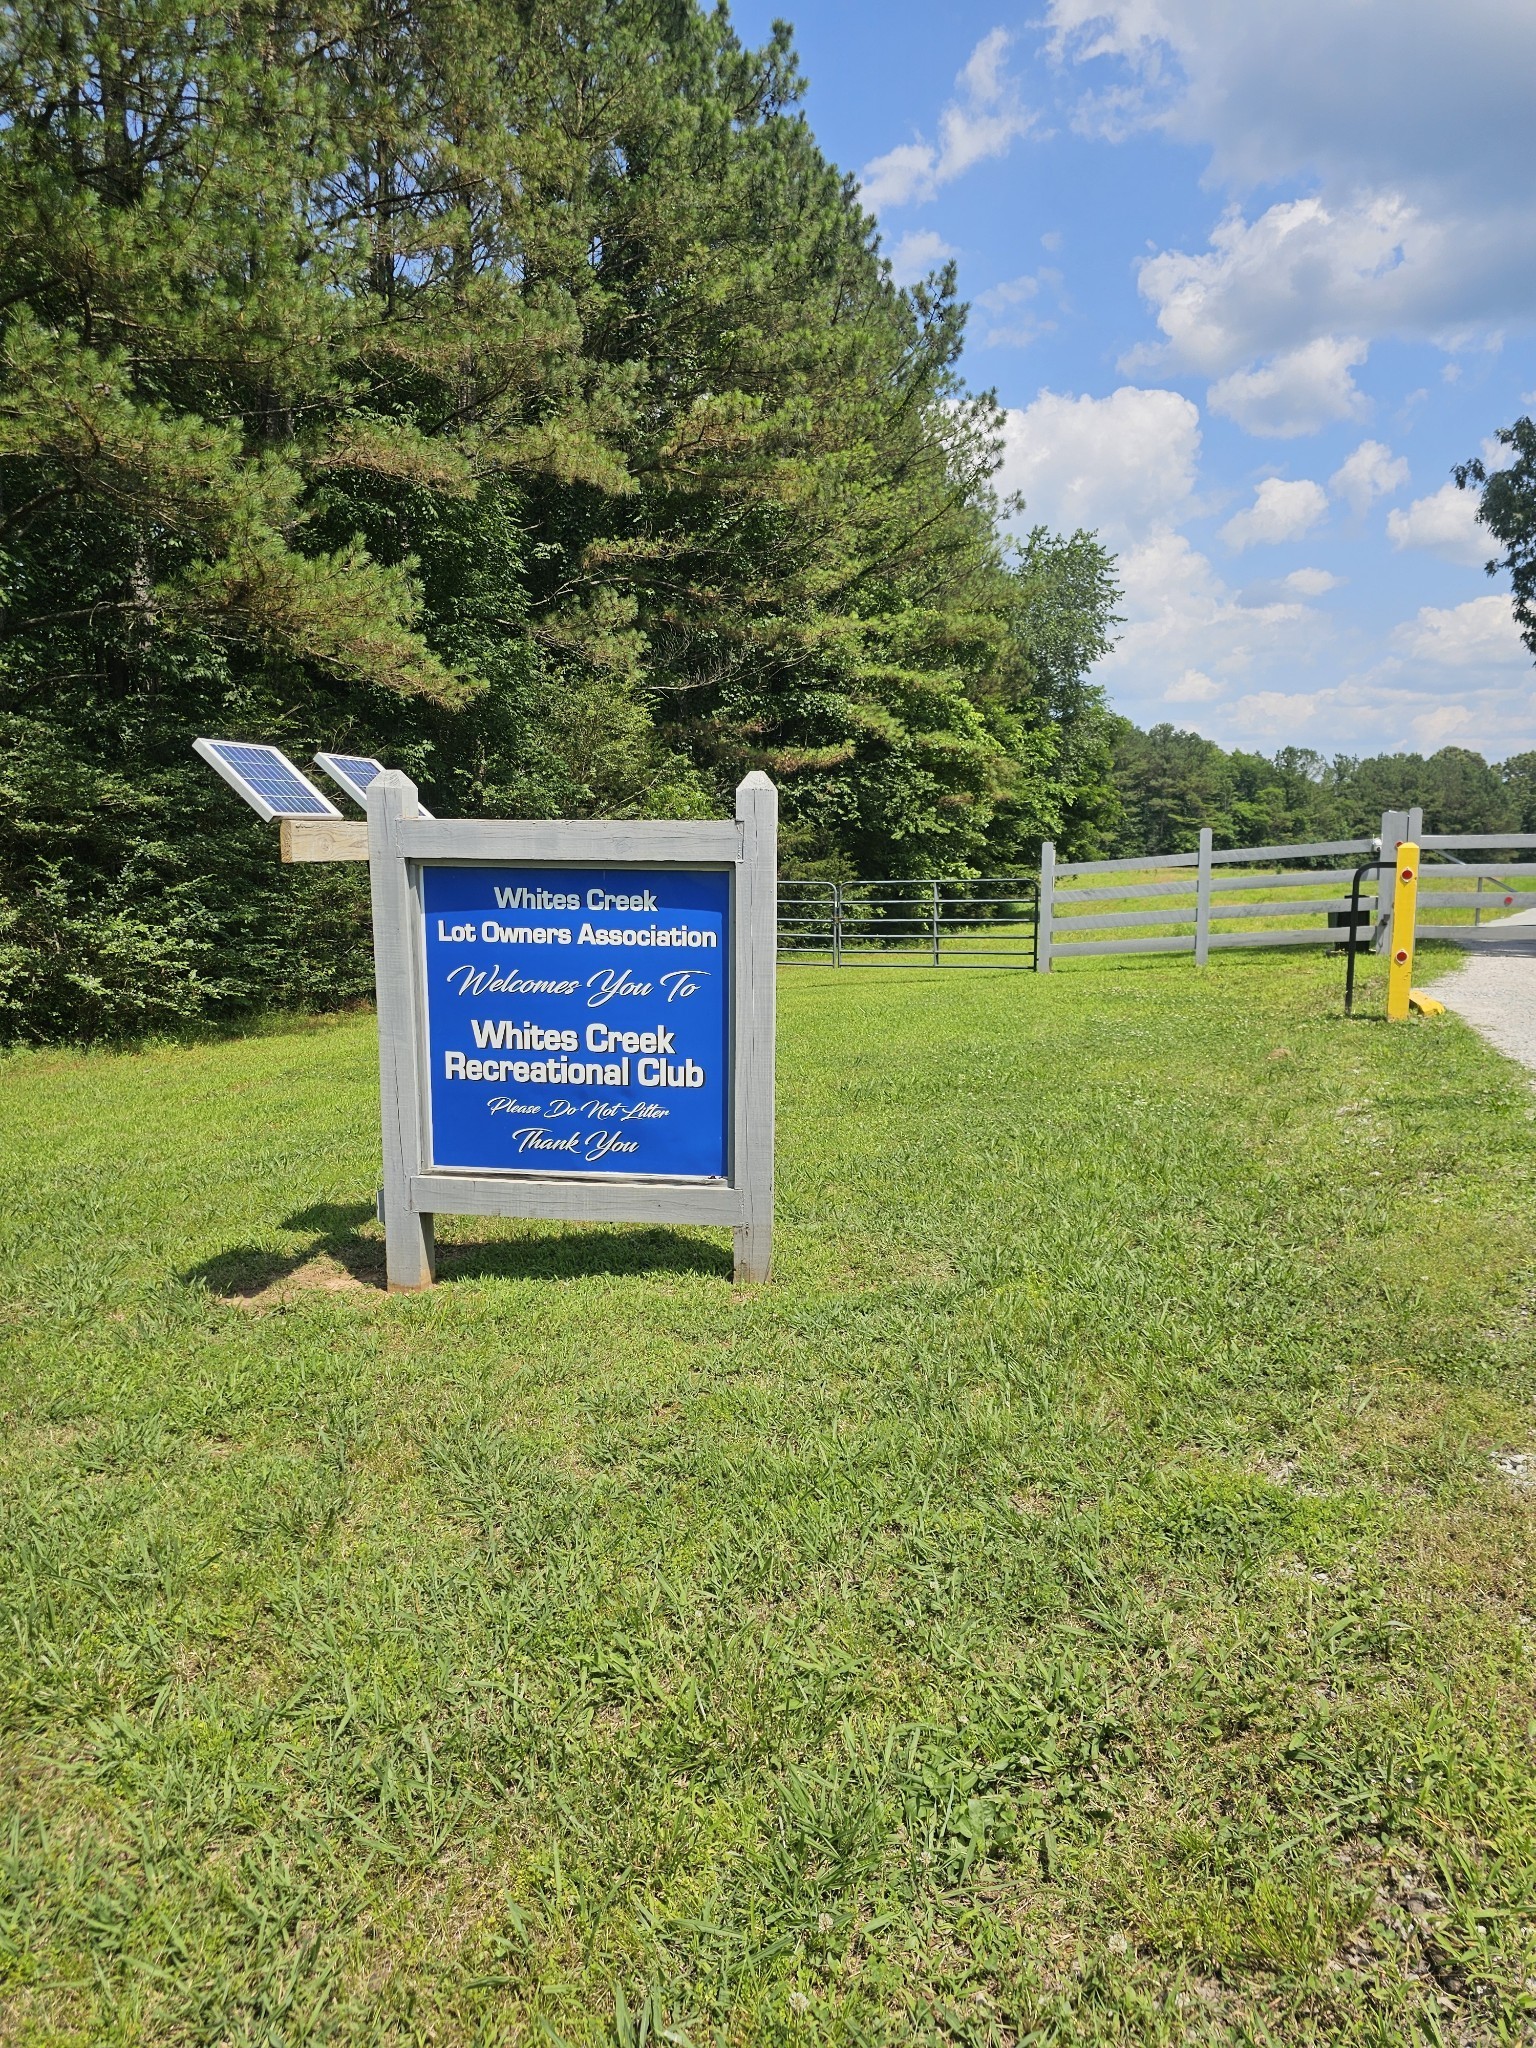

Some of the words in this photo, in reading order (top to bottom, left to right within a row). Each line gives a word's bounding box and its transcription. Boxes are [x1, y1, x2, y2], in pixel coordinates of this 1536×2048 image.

[494, 887, 580, 911] Whites
[586, 888, 658, 912] Creek
[438, 920, 476, 942] Lot
[482, 921, 572, 945] Owners
[577, 923, 717, 948] Association
[447, 965, 582, 996] Welcomes
[587, 969, 653, 1008] You
[660, 970, 711, 1002] To
[471, 1020, 578, 1052] Whites
[586, 1023, 675, 1055] Creek
[445, 1051, 629, 1086] Recreational
[637, 1057, 704, 1088] Club
[487, 1096, 541, 1116] Please
[544, 1099, 578, 1118] Do
[580, 1100, 620, 1119] Not
[620, 1102, 670, 1122] Litter
[512, 1127, 582, 1154] Thank
[585, 1131, 640, 1162] You
